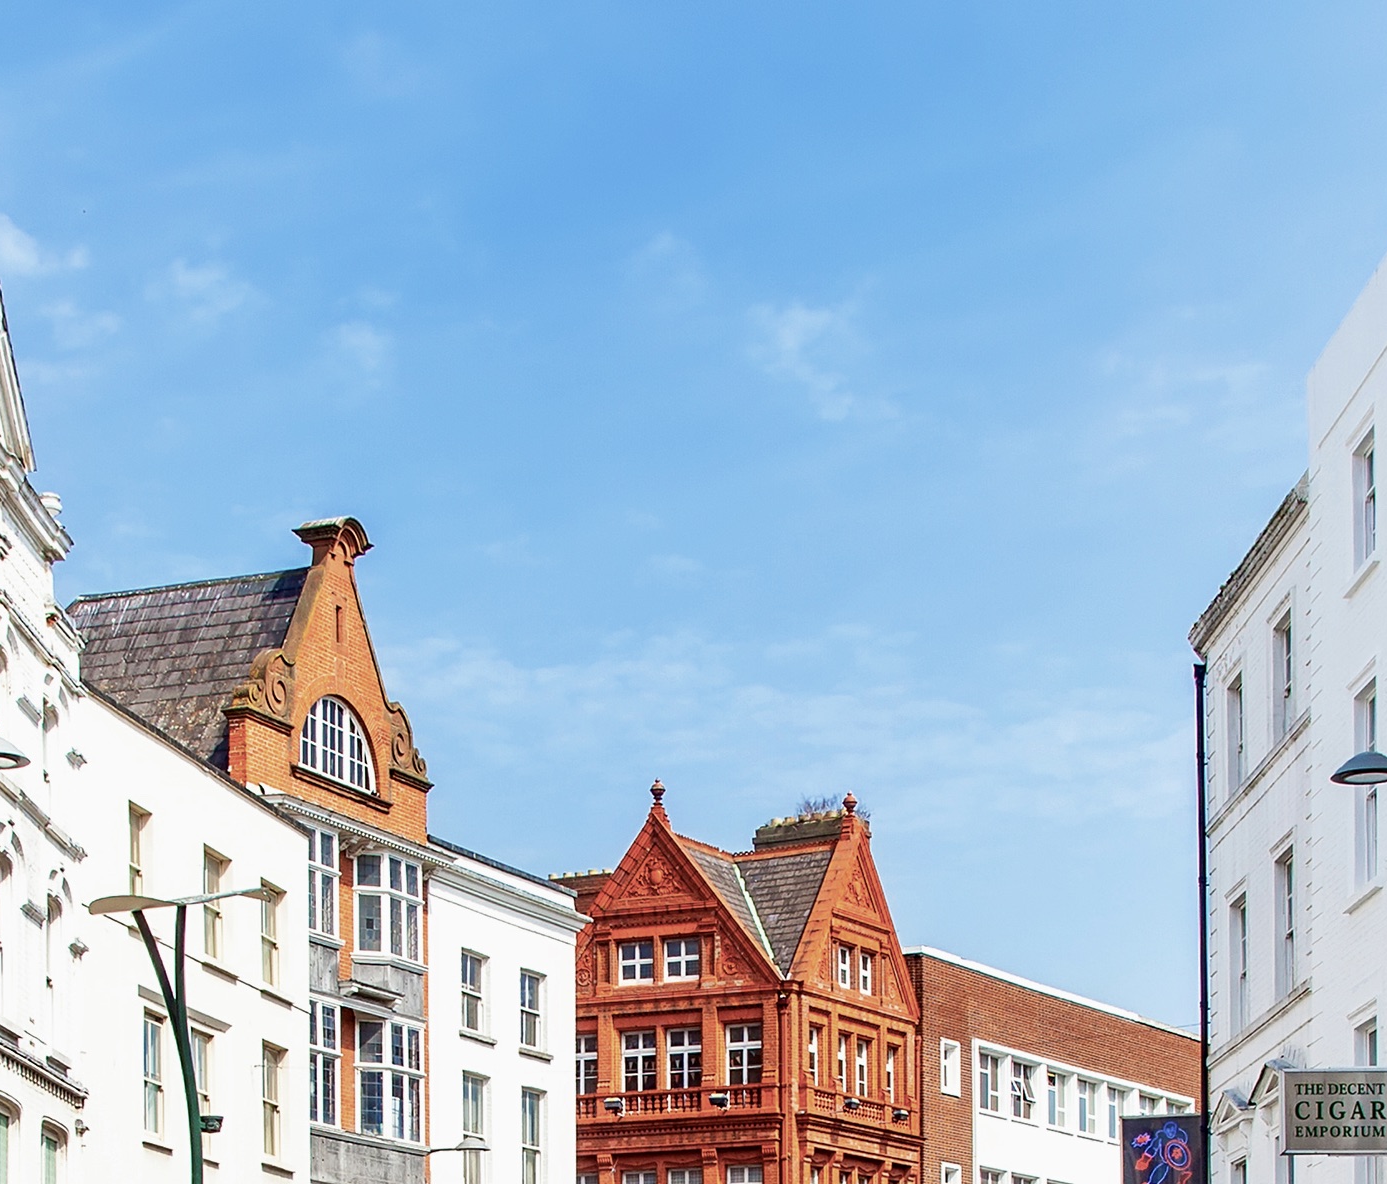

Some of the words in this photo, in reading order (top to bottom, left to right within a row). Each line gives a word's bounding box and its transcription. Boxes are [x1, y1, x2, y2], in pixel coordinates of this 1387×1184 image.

[1294, 1083, 1324, 1095] THE
[1328, 1083, 1385, 1095] DECENT
[1294, 1100, 1387, 1120] CIGAR
[1295, 1126, 1385, 1137] EMPORIUM
